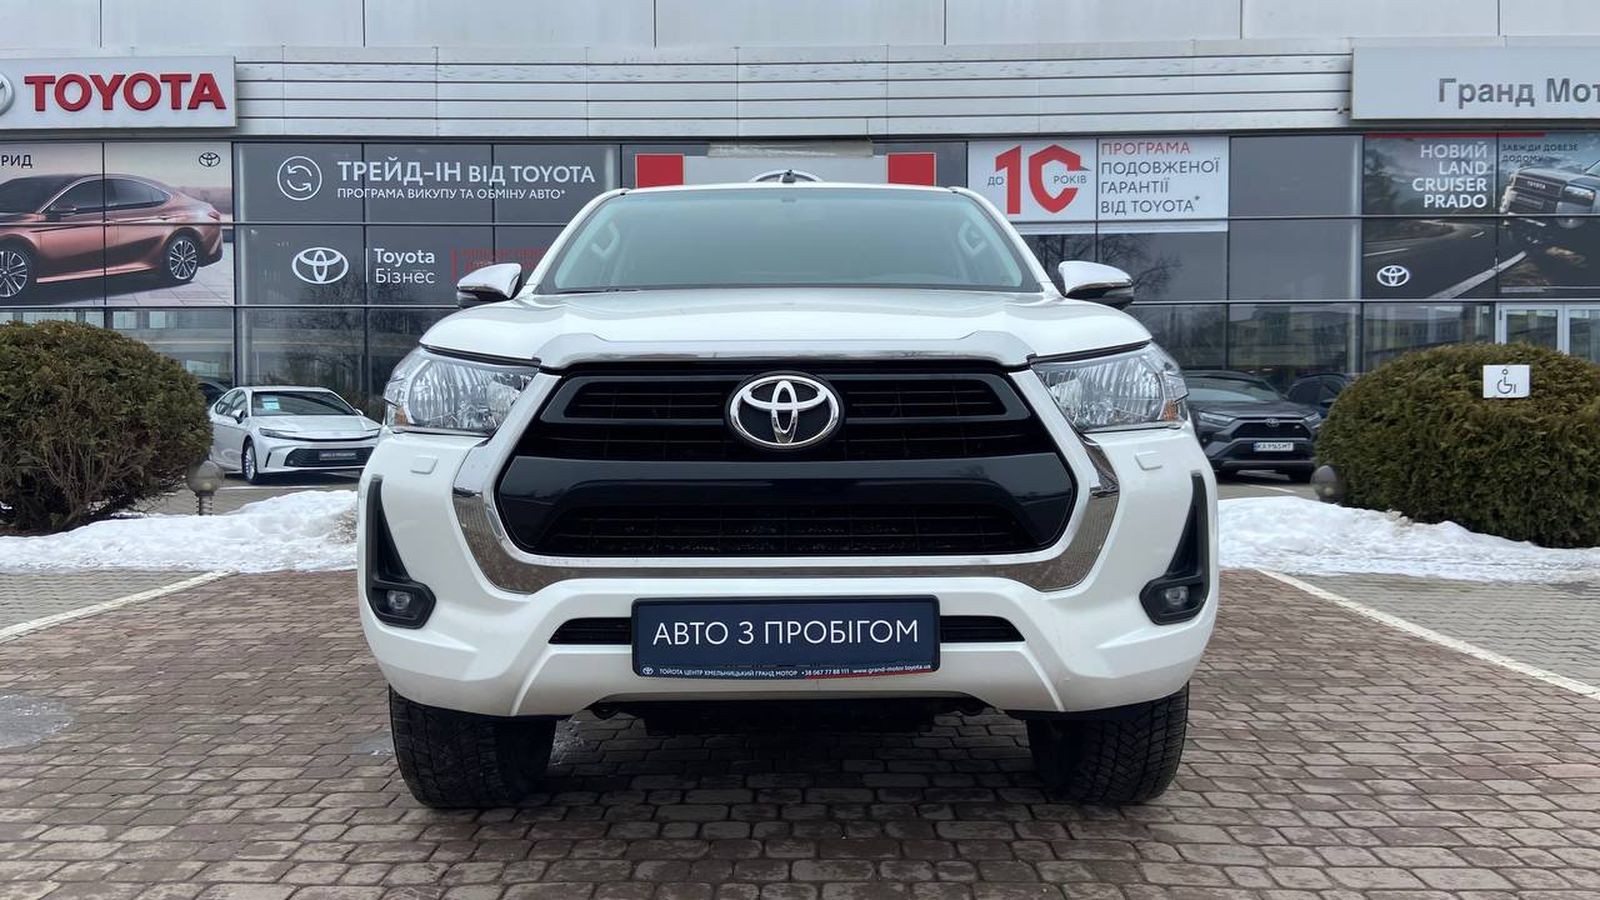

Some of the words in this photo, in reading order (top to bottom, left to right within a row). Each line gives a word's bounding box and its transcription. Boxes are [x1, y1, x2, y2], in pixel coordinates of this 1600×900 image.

[24, 73, 226, 112] TOYOTA
[1438, 77, 1535, 109] Гранд
[1101, 141, 1191, 156] ПРОГРАМА
[1420, 141, 1488, 159] НОВИЙ
[1, 154, 33, 169] РИД
[1101, 157, 1220, 176] ПОДОВЖЕНОЇ
[1438, 161, 1488, 175] LAND
[337, 158, 462, 186] ТРЕЙД-ІН
[469, 165, 506, 185] ВІД
[511, 165, 596, 183] TOYOTA
[1053, 174, 1088, 185] РОКІВ
[987, 176, 1005, 187] ДО
[1101, 177, 1169, 194] ГАРАНТІЇ
[1412, 177, 1488, 192] CRUISER
[337, 188, 404, 200] ПРОГРАМА
[408, 188, 456, 200] ВИКУПУ
[459, 188, 474, 200] ТА
[477, 188, 527, 200] ОБМІНУ
[1424, 194, 1488, 209] PRADO
[1101, 201, 1127, 216] ВІД
[374, 248, 435, 267] Toyota
[375, 268, 436, 284] Бізнес
[653, 621, 728, 646] АВТО
[738, 621, 754, 646] З
[765, 619, 919, 645] ПРОБІГОМ
[659, 667, 683, 675] ТОЙОТА
[684, 668, 703, 676] ЦЕНТР
[755, 669, 775, 678] ГРАНД
[776, 669, 798, 677] МОТОР
